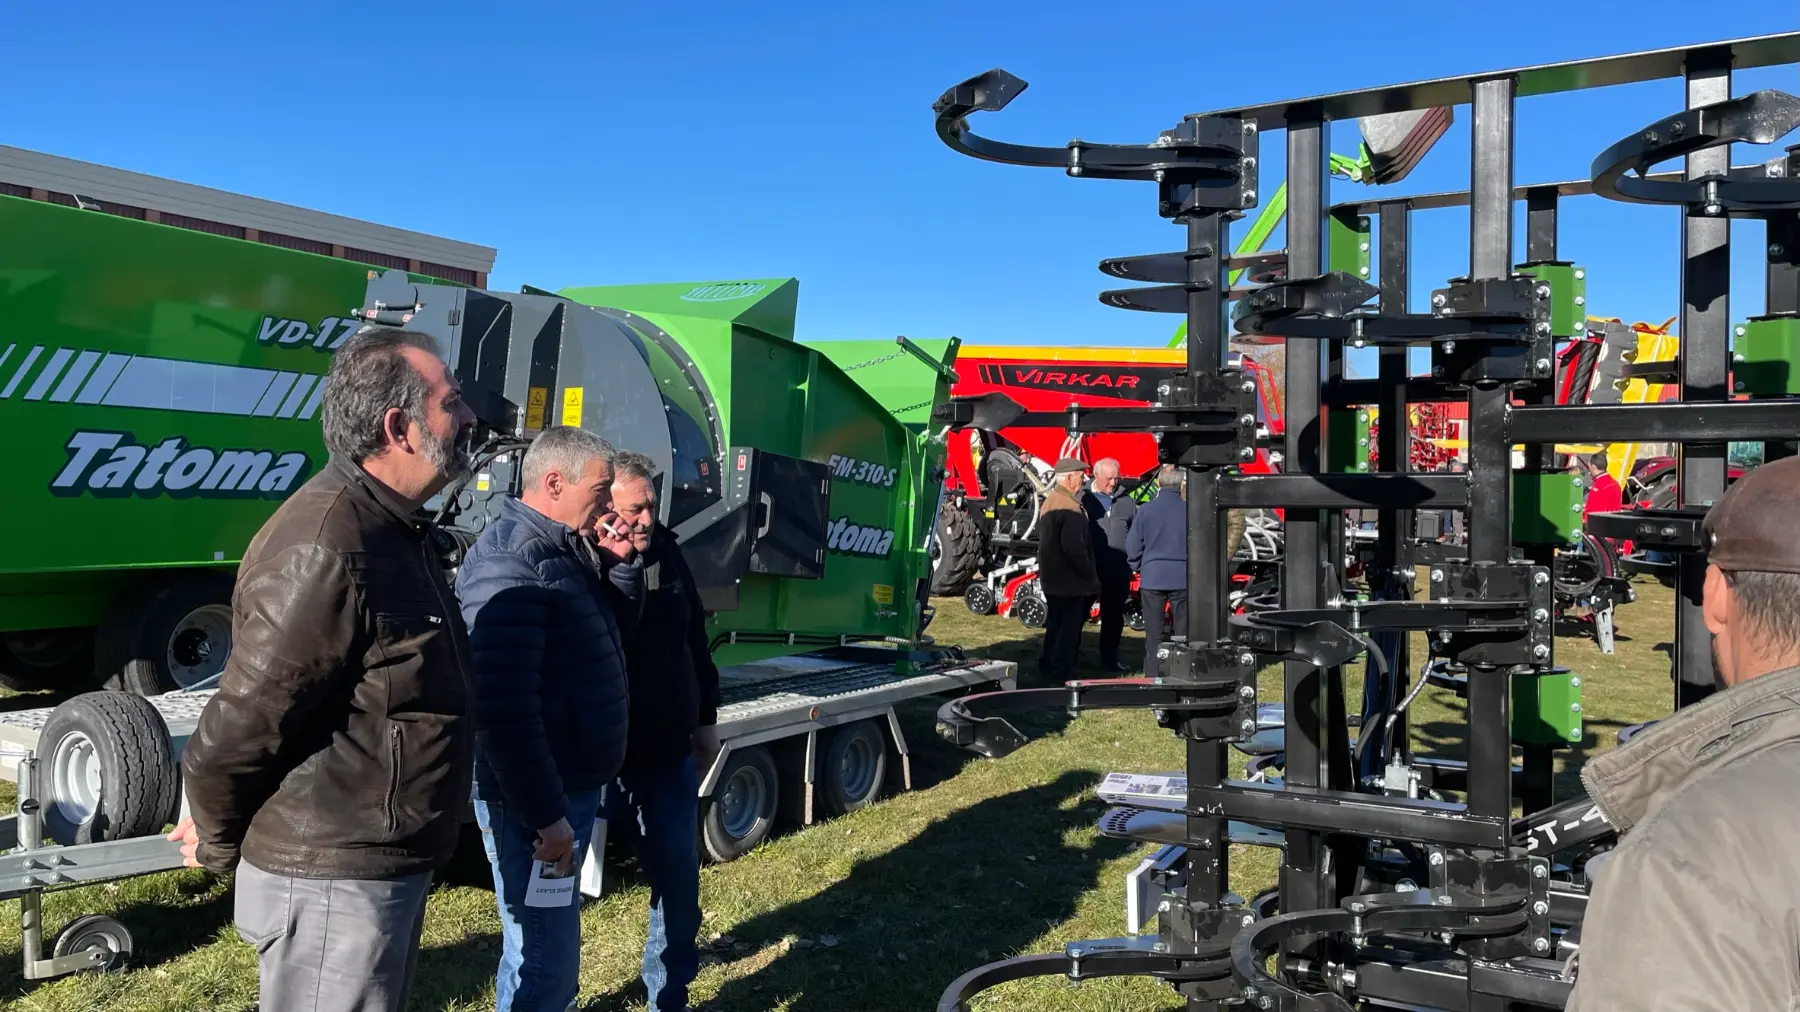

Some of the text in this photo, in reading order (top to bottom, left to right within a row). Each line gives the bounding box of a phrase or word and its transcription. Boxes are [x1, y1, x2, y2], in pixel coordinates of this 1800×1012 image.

[1015, 368, 1140, 388] VIRKAR
[51, 431, 307, 493] Tatoma
[827, 516, 895, 555] toma
